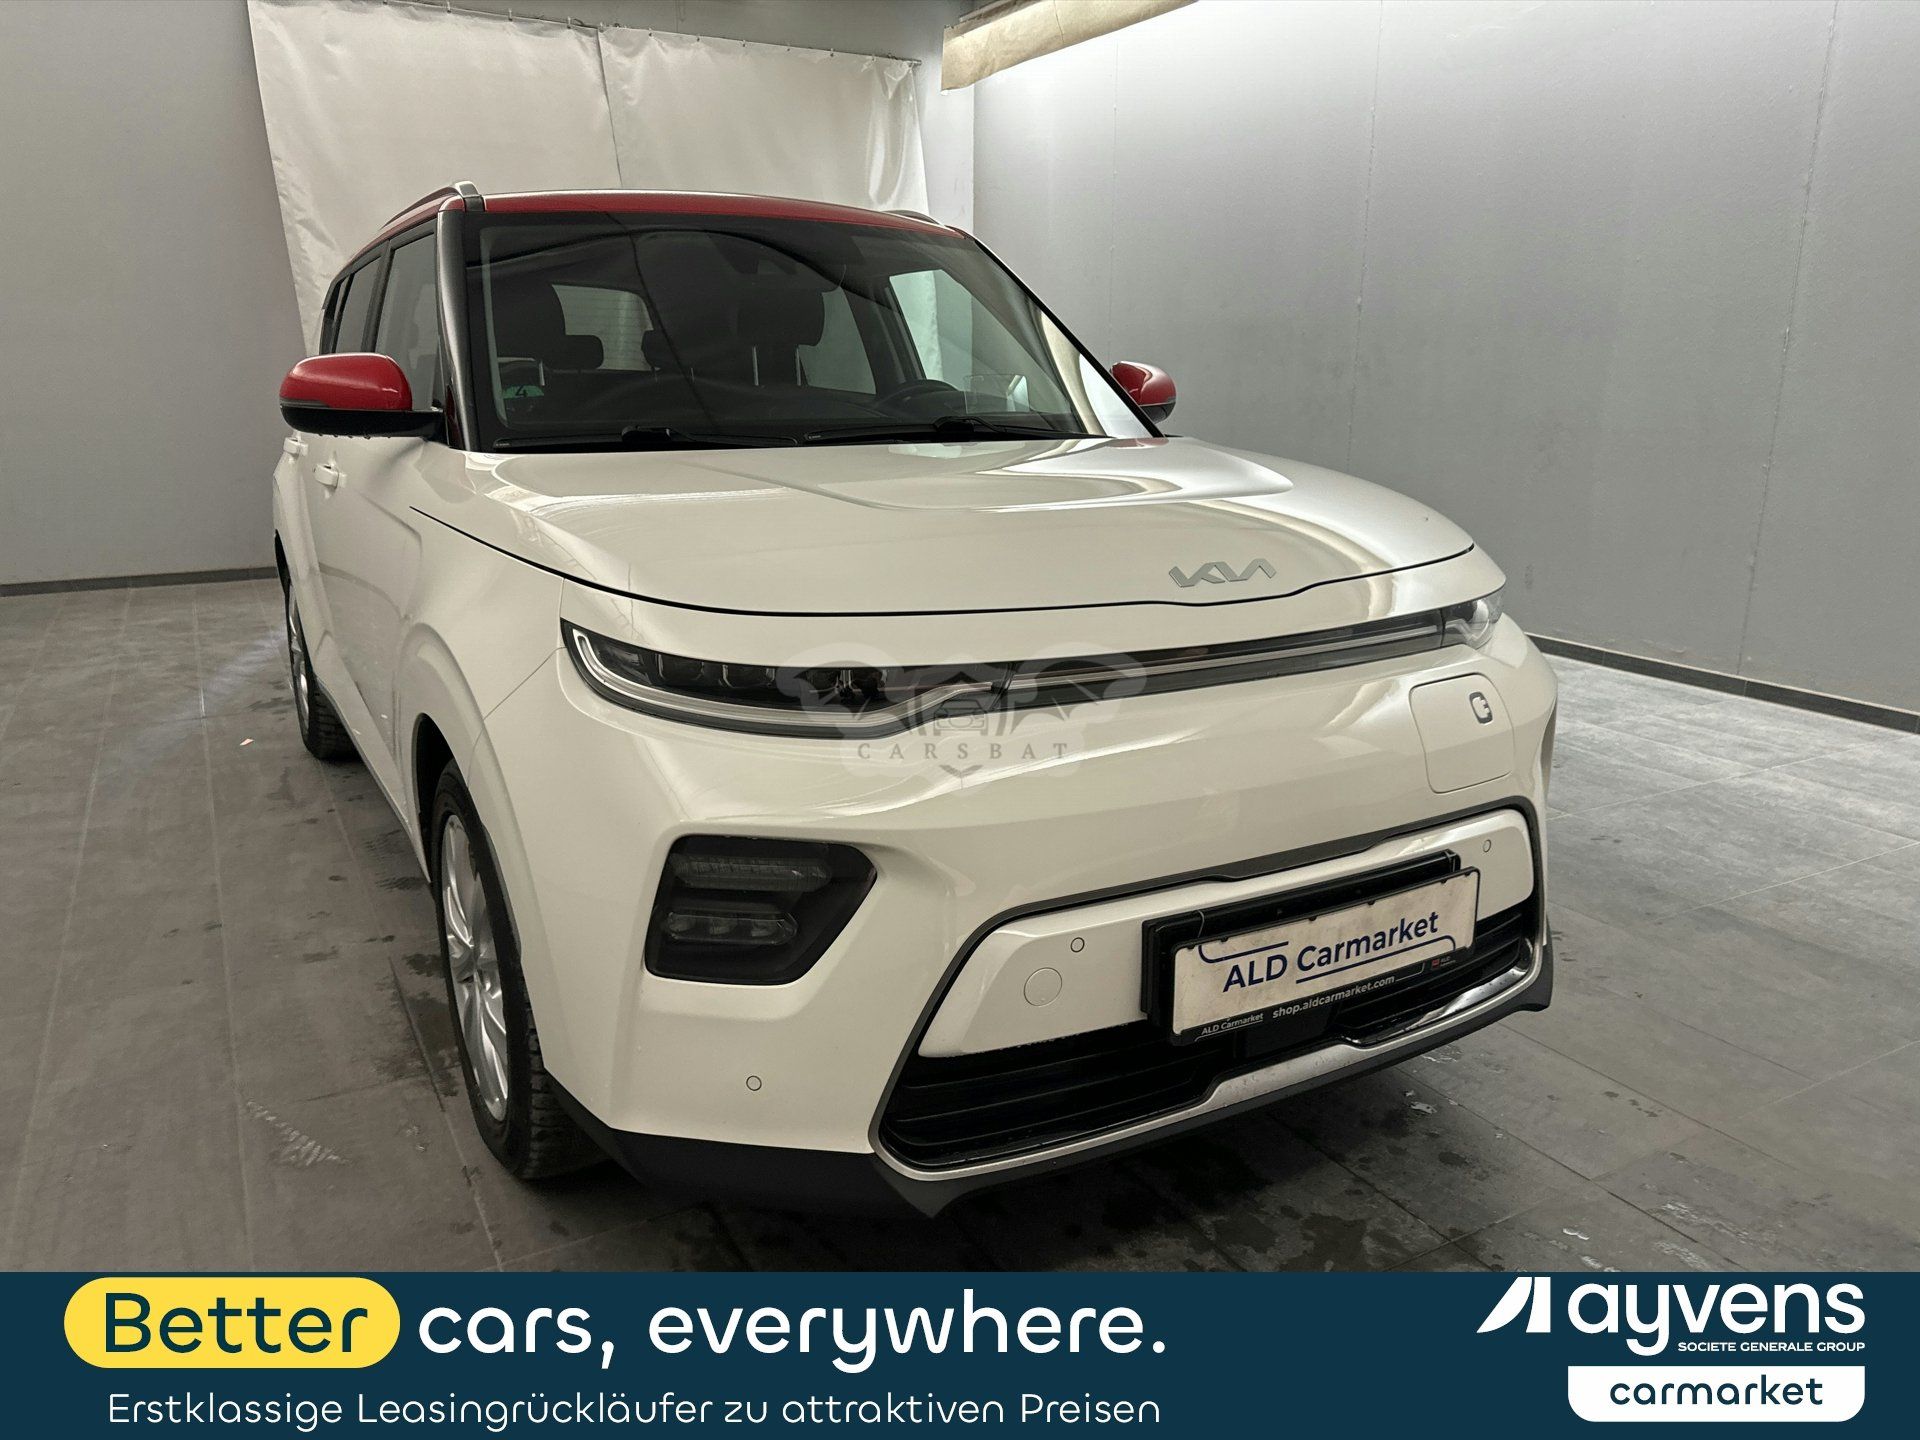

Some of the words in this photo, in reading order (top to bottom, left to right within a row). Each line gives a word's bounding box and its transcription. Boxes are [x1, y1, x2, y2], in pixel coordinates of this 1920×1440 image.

[1222, 953, 1288, 993] ALD
[1296, 911, 1439, 972] Carmarket
[1272, 976, 1395, 1019] shop.aldcarmarket.com
[1201, 1024, 1220, 1036] ALD
[1220, 1012, 1264, 1030] Carmarket
